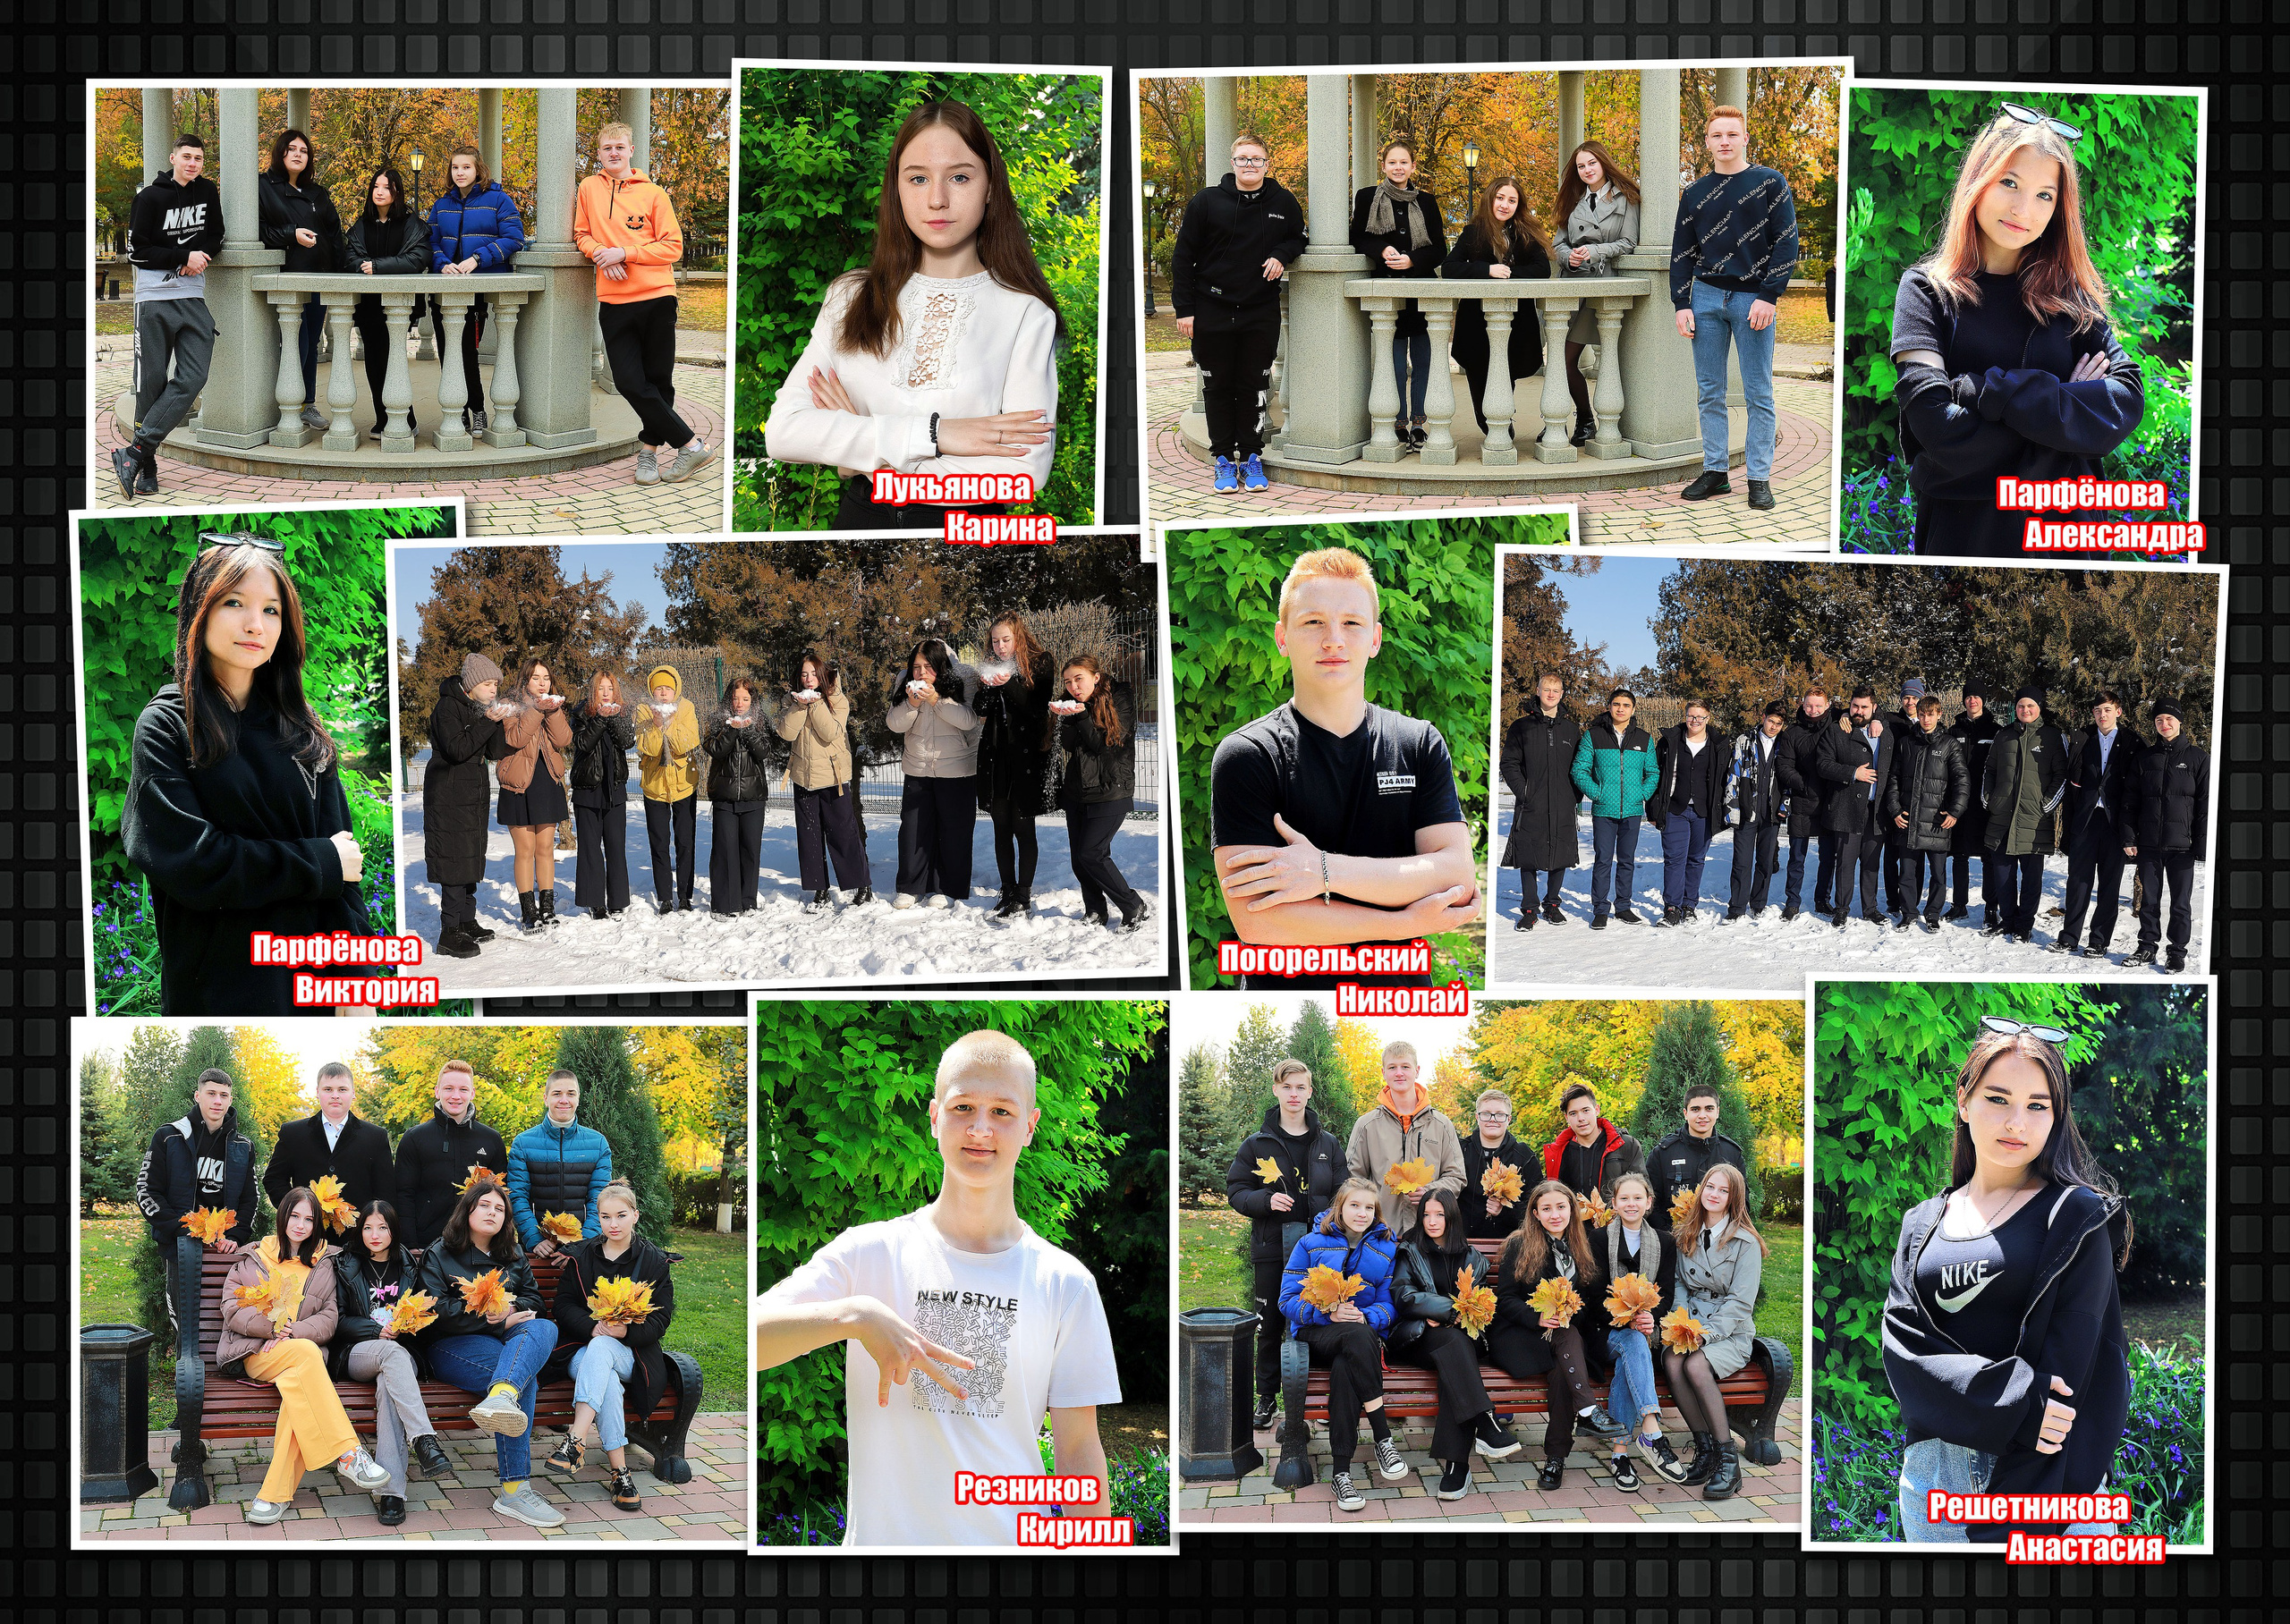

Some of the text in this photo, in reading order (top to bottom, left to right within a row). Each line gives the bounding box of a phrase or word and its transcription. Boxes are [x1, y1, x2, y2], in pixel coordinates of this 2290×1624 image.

[1697, 176, 1733, 209] BALENCIAGA
[1738, 178, 1777, 205] BALENCIAGA
[1941, 1259, 1989, 1290] NIKE
[918, 1290, 1018, 1311] NEW STYLE
[912, 1391, 1005, 1414] NEW STYLE
